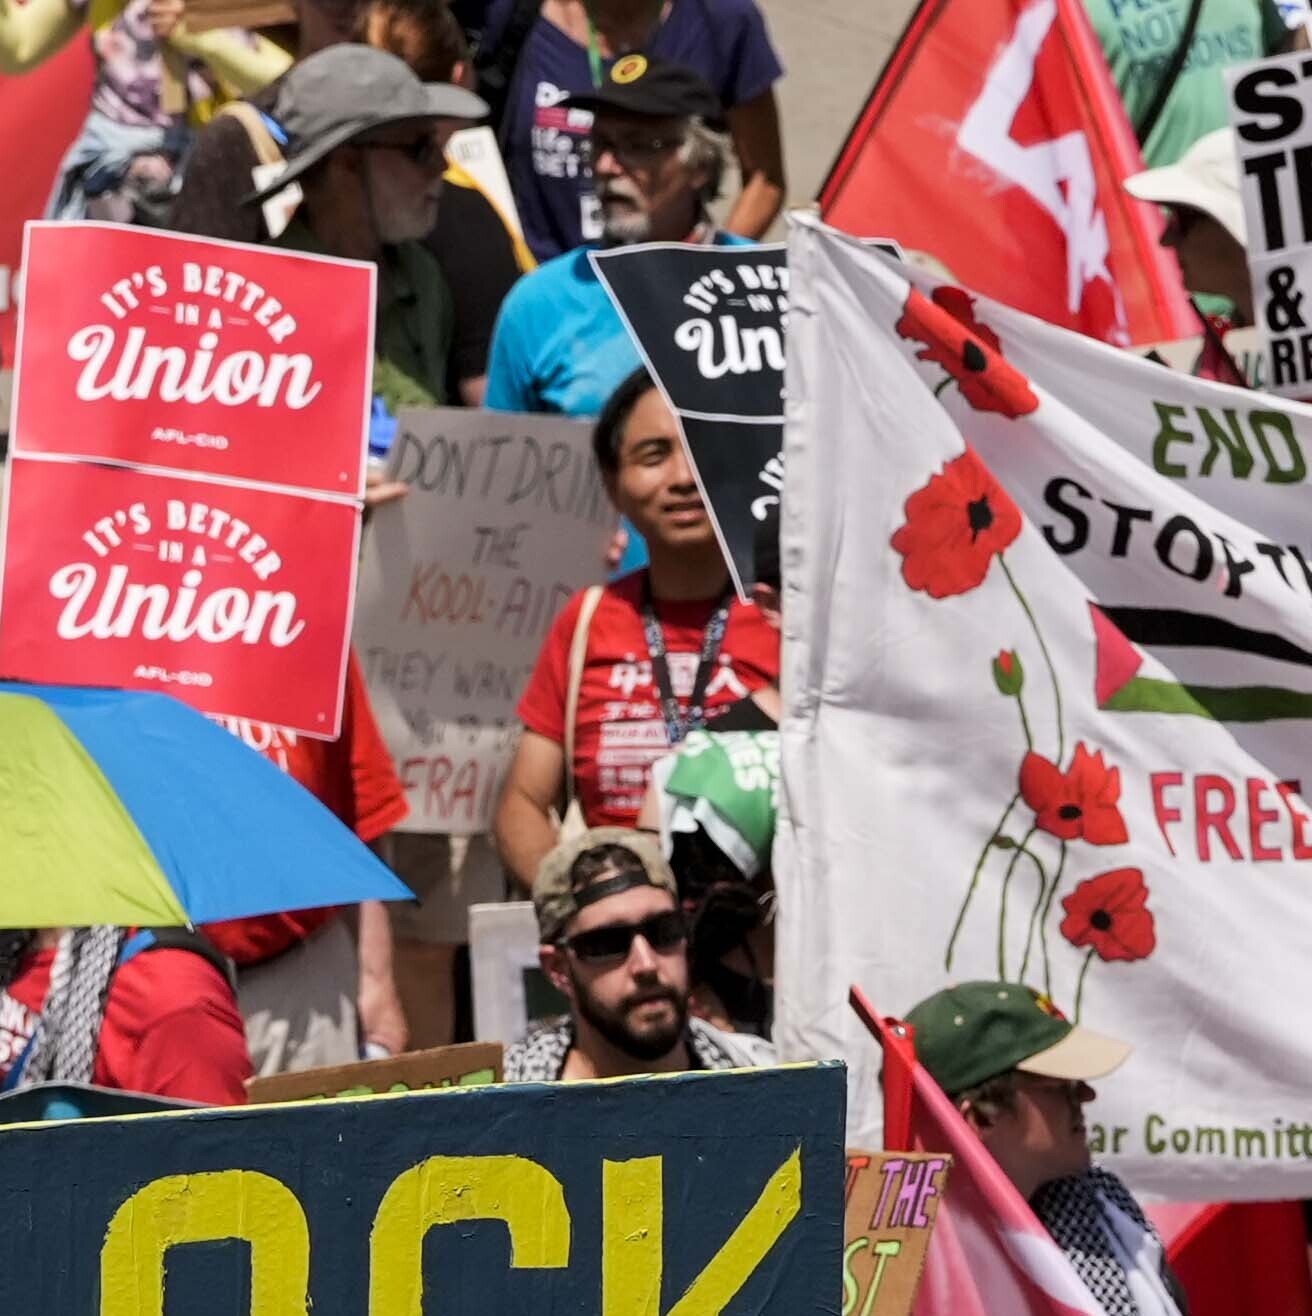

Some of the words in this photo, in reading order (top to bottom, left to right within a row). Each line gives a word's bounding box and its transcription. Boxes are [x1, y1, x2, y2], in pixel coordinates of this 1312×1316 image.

[99, 263, 169, 321] IT'S
[182, 261, 299, 345] BETTER
[174, 302, 200, 327] IN
[207, 306, 224, 331] A
[682, 268, 736, 315] IT'S
[1265, 263, 1310, 333] &
[66, 323, 324, 412] Union
[391, 431, 510, 499] DON'T
[1150, 400, 1307, 485] END
[81, 500, 153, 558] IT'S
[165, 498, 283, 583] BETTER
[157, 540, 184, 564] IN
[190, 543, 208, 568] A
[472, 521, 531, 571] THE
[48, 561, 307, 649] Union
[868, 1156, 945, 1231] THE
